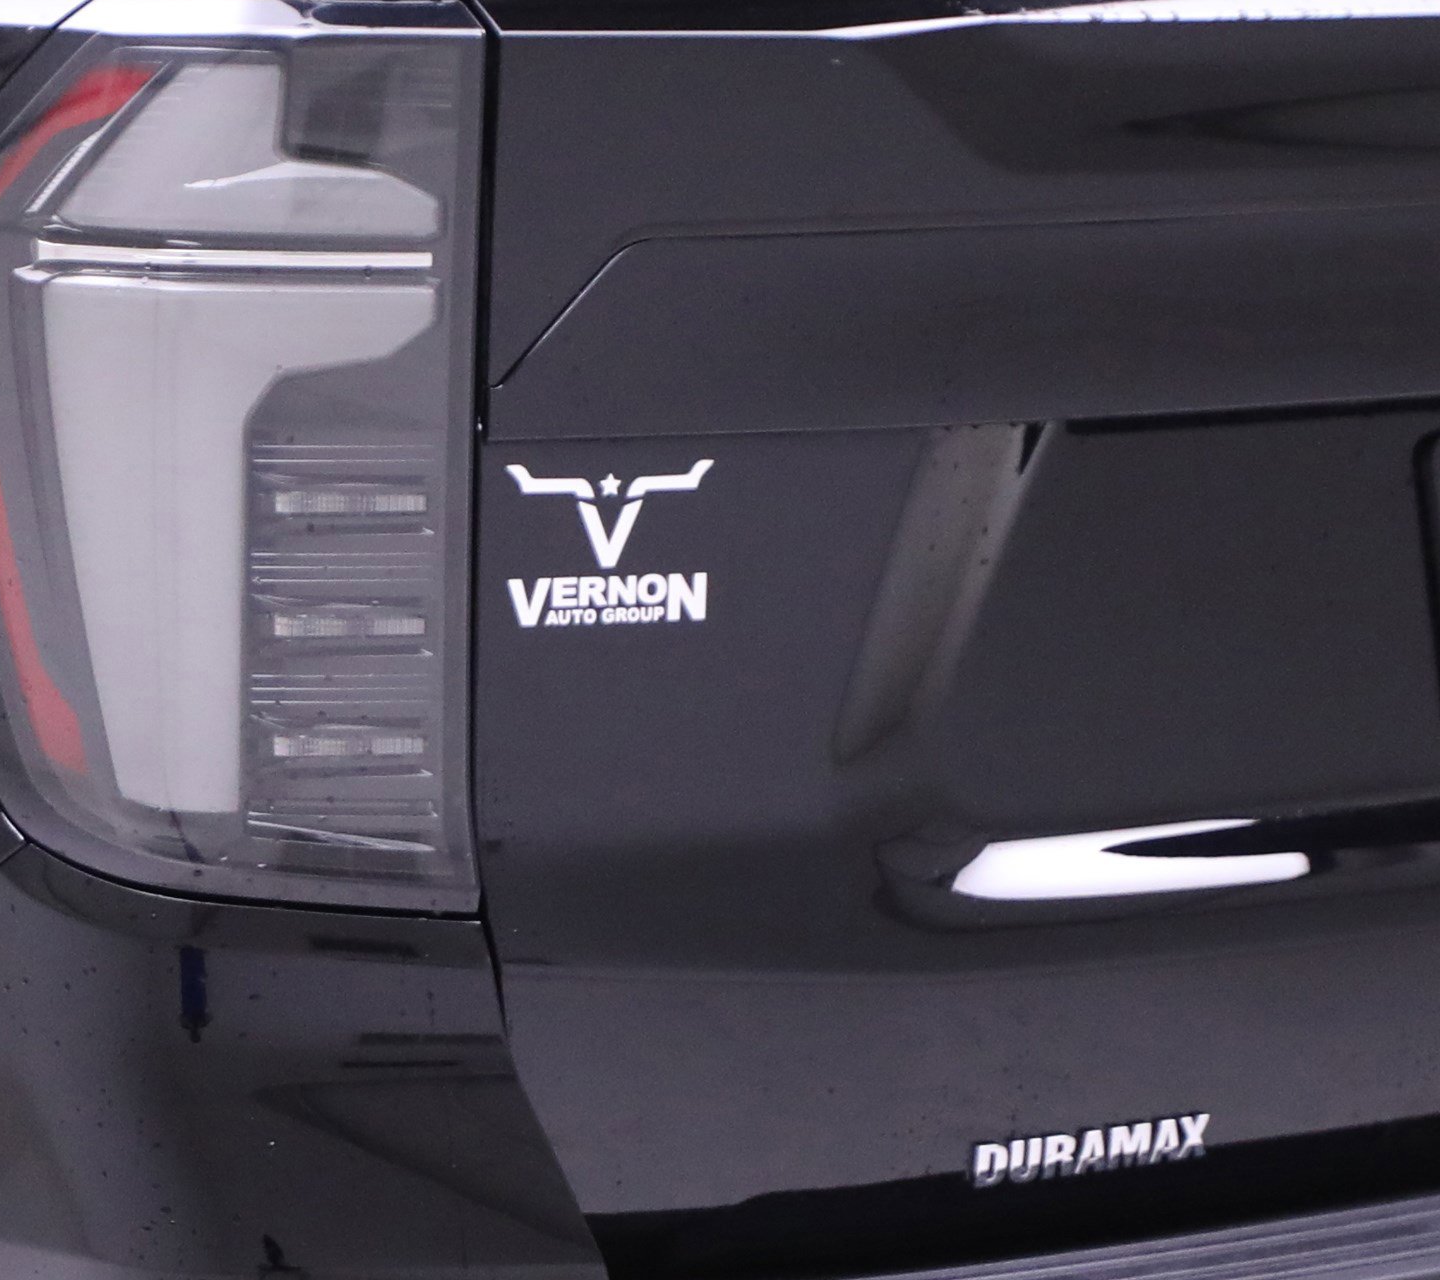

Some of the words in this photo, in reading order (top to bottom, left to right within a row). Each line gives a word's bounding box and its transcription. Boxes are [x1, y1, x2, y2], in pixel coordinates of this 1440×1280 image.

[506, 571, 708, 628] VERNON
[544, 608, 598, 626] AUTO
[601, 605, 665, 624] GROUP
[973, 1112, 1211, 1189] DURAMAX
